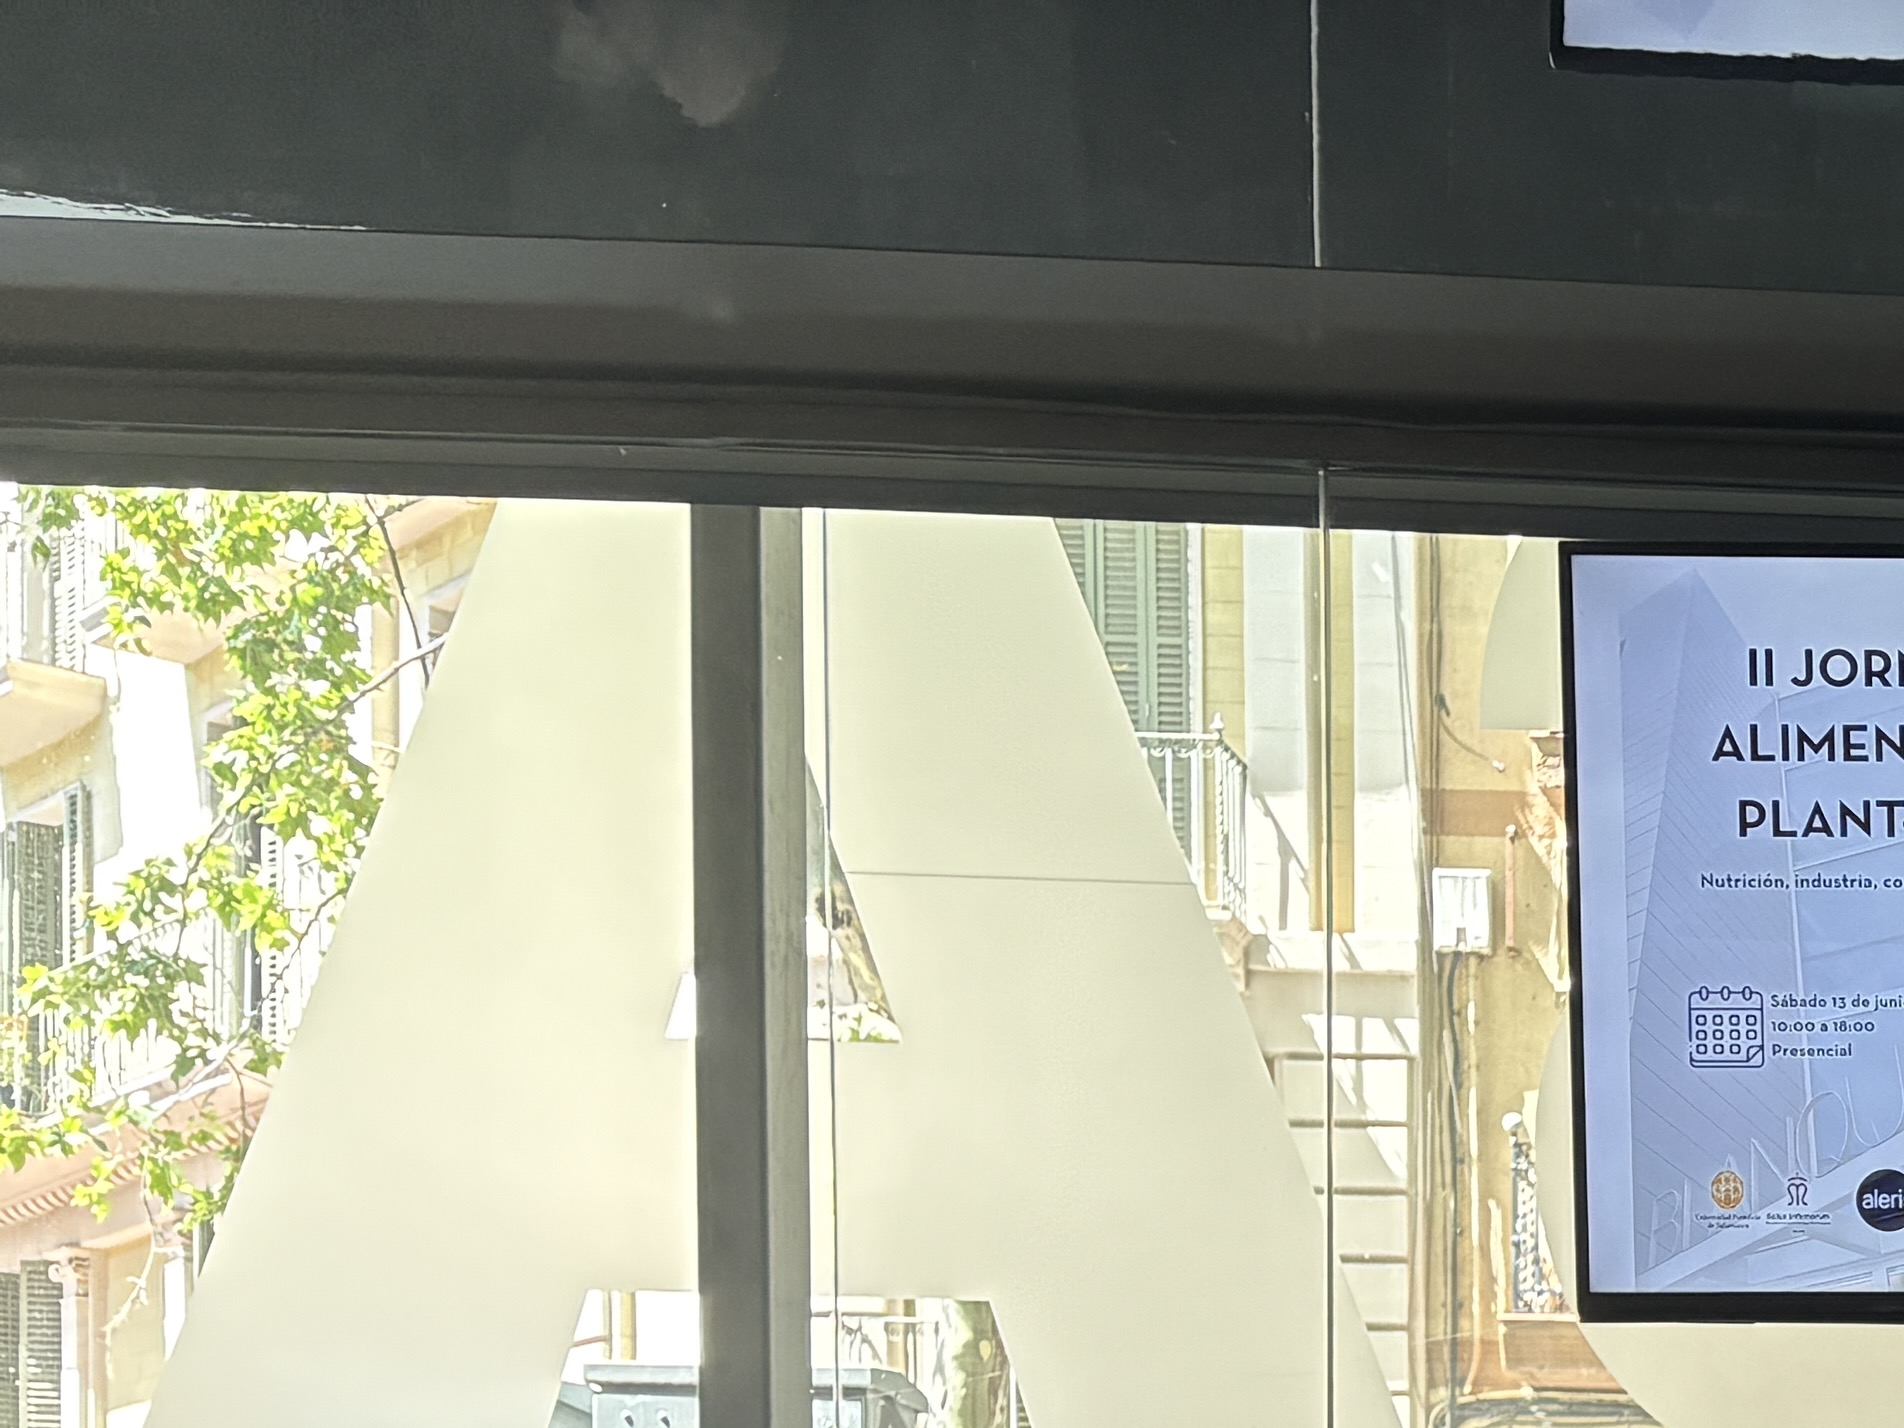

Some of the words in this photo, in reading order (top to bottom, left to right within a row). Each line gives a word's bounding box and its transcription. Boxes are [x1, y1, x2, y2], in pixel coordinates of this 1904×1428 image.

[1747, 647, 1774, 688] II
[1699, 872, 1790, 891] Nutrición,
[1794, 872, 1878, 891] industria,
[1770, 993, 1828, 1008] Sábado
[1831, 996, 1847, 1009] 13
[1771, 1021, 1815, 1033] 10:00
[1820, 1022, 1829, 1033] a
[1832, 1021, 1875, 1033] 18:00
[1771, 1043, 1853, 1057] Presencial
